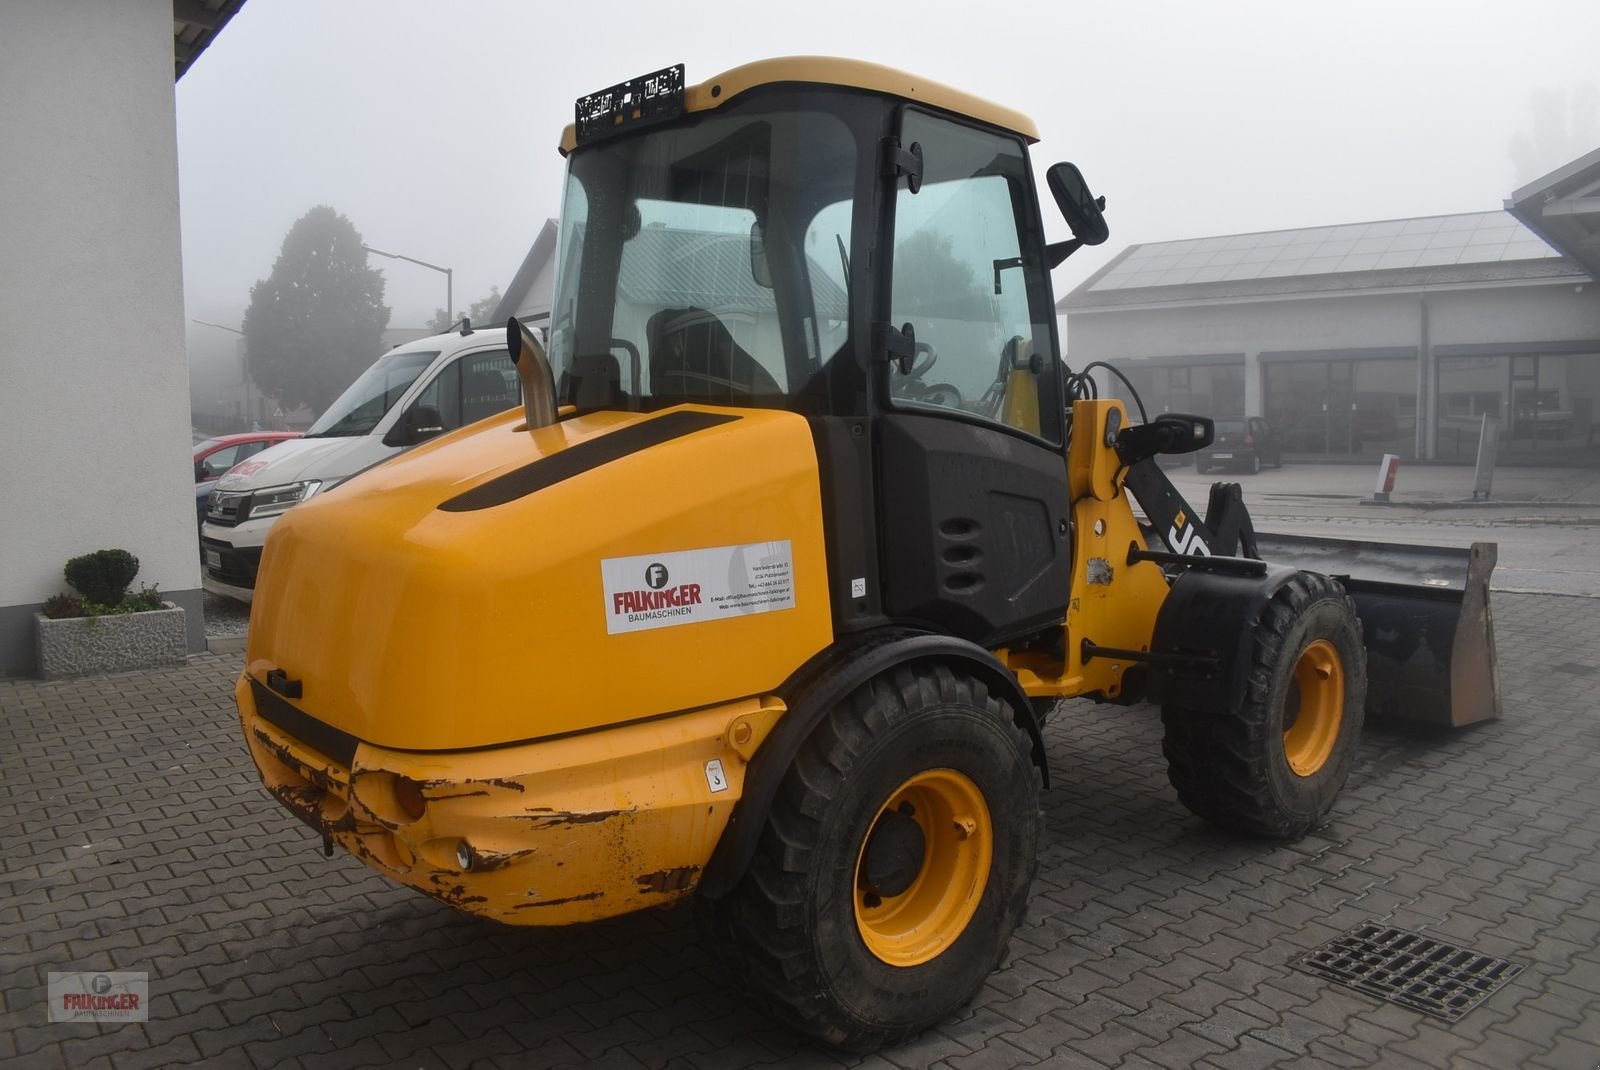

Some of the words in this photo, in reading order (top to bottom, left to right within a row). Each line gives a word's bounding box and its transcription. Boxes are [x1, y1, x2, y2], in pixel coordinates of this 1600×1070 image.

[650, 566, 663, 587] F
[613, 583, 702, 615] FALKINGER
[628, 607, 692, 623] BAUMASCHINEN
